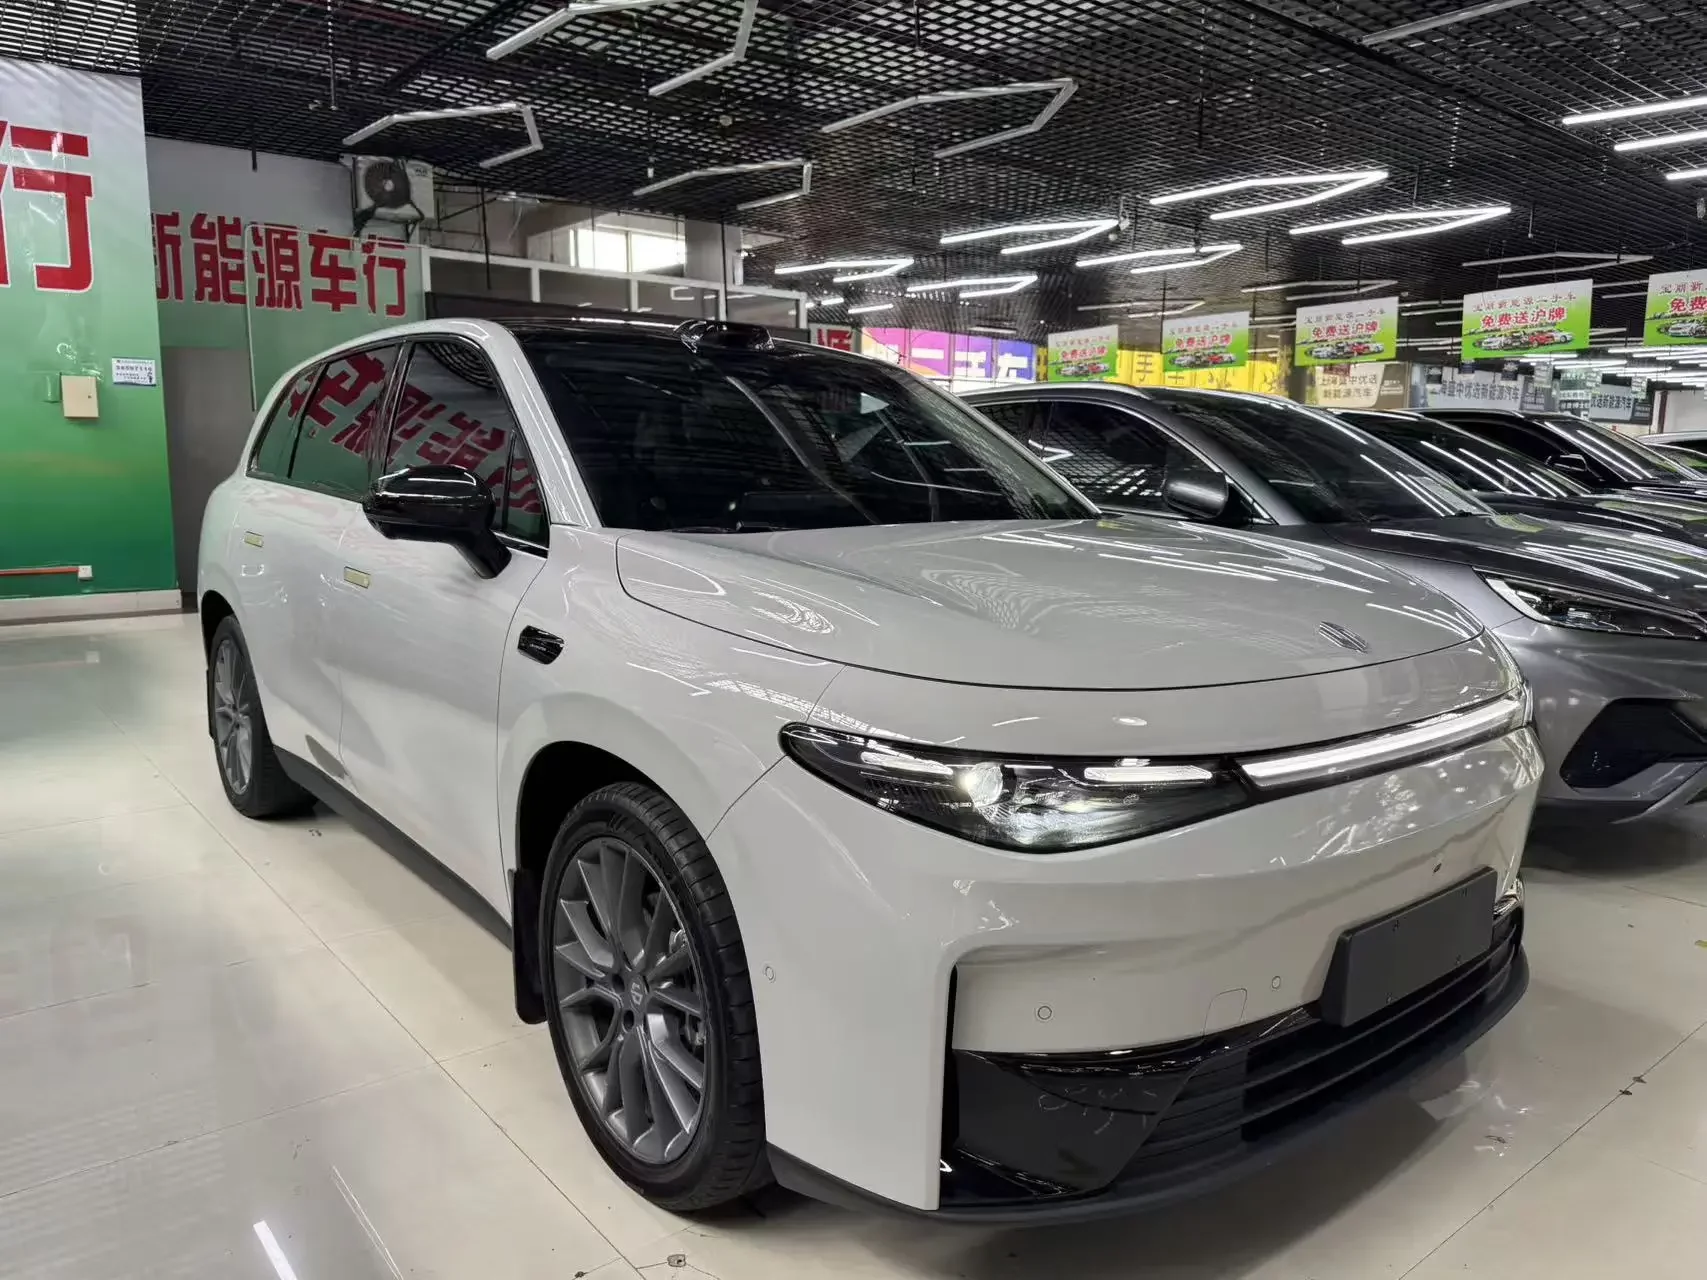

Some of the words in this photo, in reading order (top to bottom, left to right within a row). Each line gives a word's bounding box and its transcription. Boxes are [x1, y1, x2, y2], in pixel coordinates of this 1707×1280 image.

[0, 121, 93, 291] 行
[1482, 307, 1565, 328] 免费送沪牌
[1312, 320, 1378, 339] 免费送沪牌
